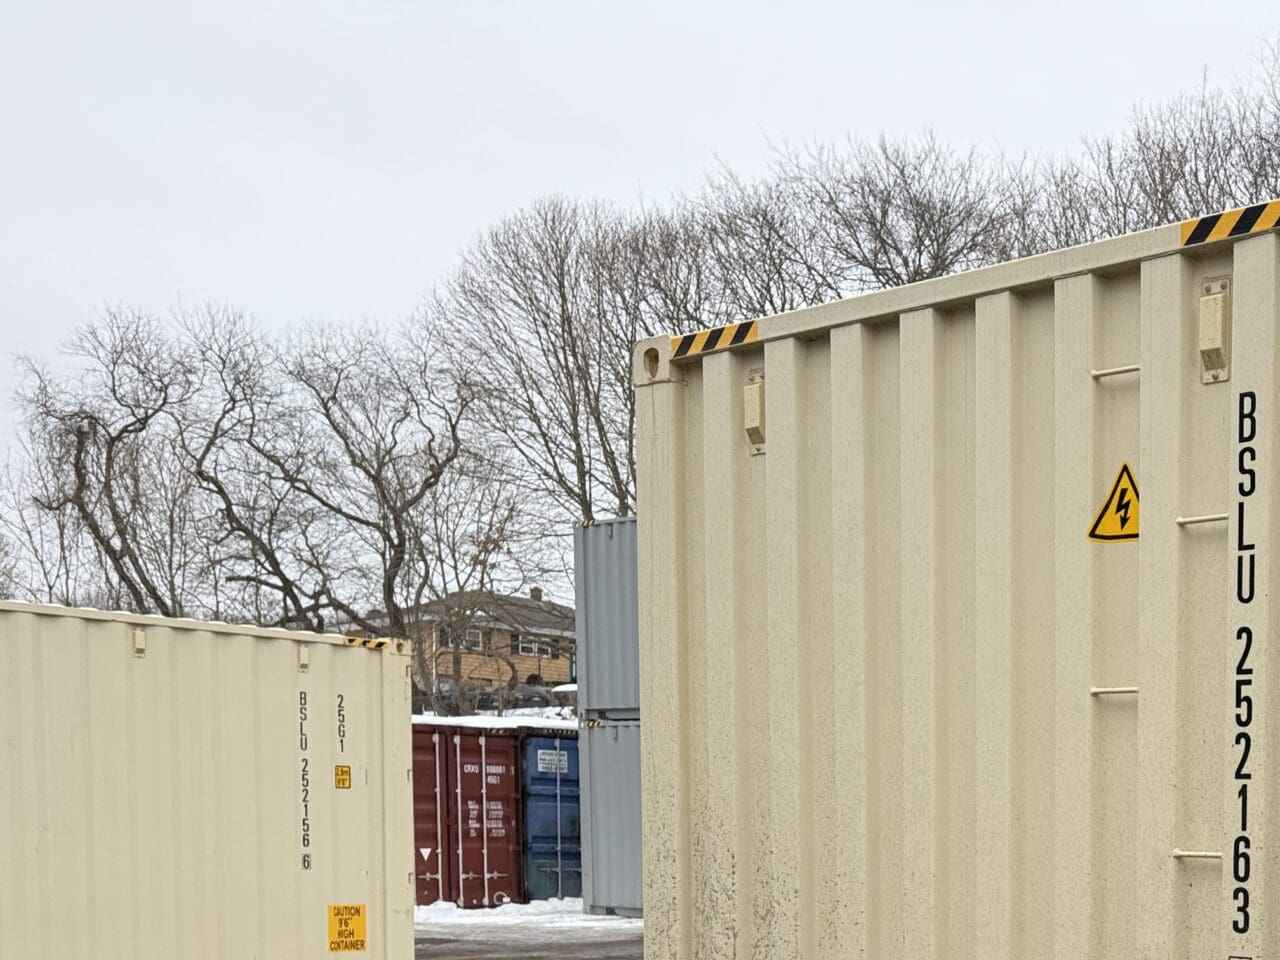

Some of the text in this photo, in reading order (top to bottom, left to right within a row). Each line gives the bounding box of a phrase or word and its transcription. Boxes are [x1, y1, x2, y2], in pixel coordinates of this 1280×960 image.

[1235, 391, 1257, 604] BSLU
[299, 691, 310, 869] BSLU 252156 6
[337, 694, 346, 753] 25G1
[1230, 626, 1254, 934] 252163
[337, 929, 355, 939] HIGH
